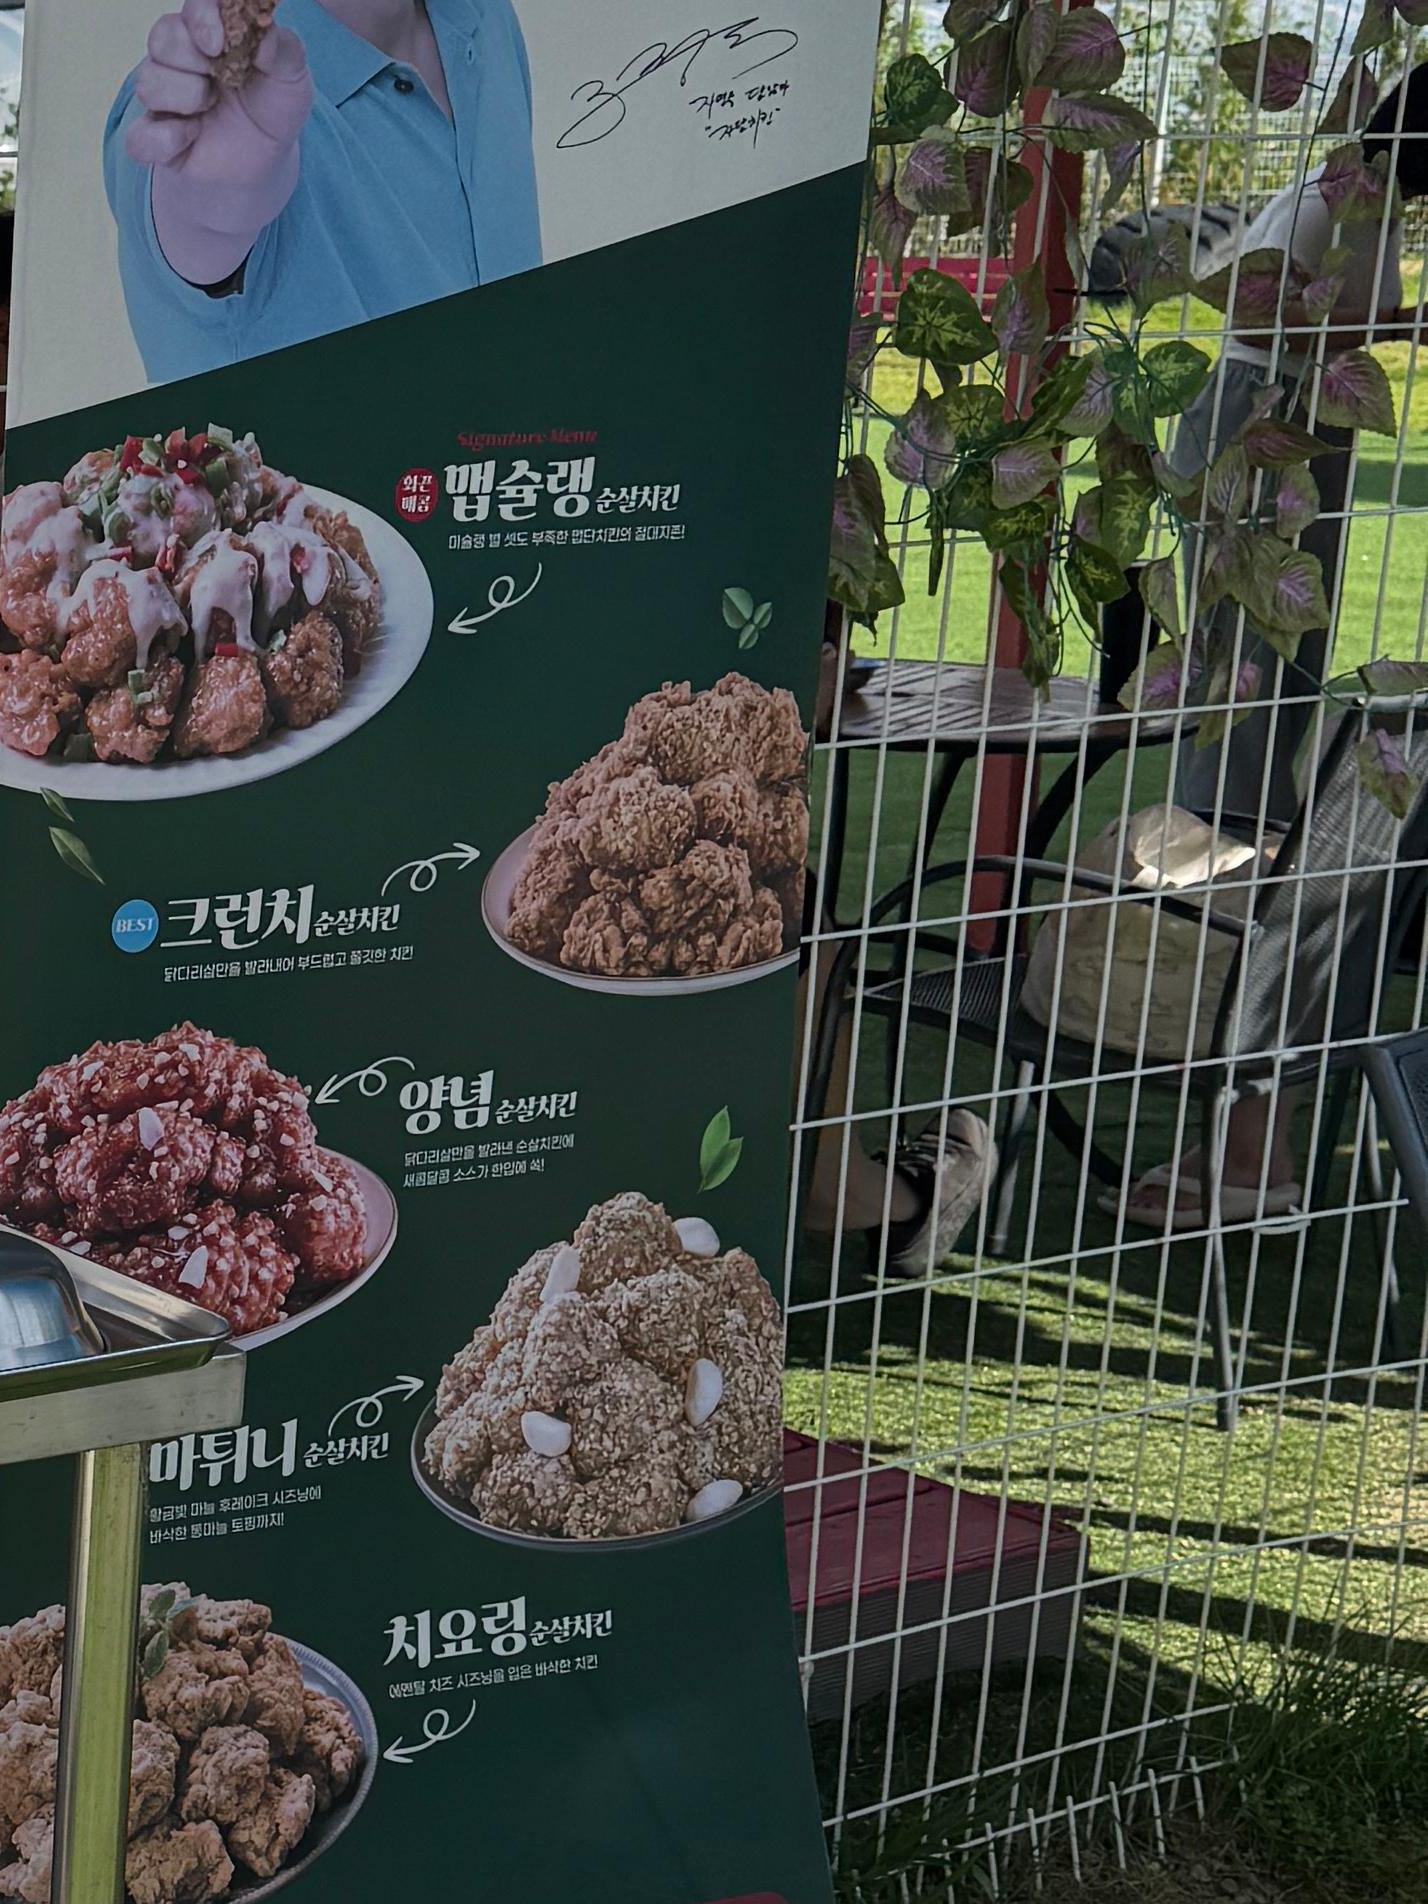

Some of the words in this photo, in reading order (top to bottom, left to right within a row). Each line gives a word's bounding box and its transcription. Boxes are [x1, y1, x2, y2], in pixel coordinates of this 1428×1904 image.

[444, 456, 596, 522] 맵슐랭
[595, 484, 681, 514] 순살치킨
[116, 917, 155, 934] BEST
[160, 884, 314, 950] 크런치
[314, 904, 401, 938] 순살치킨
[389, 946, 414, 961] 치킨
[399, 1070, 494, 1135] 양념
[495, 1091, 578, 1125] 순살치킨
[453, 1165, 489, 1182] 소스가
[148, 1418, 298, 1491] 마튀니
[303, 1432, 390, 1468] 순살치킨
[383, 1595, 527, 1668] 치요링
[529, 1609, 612, 1647] 순살치킨
[574, 1654, 598, 1670] 치킨
